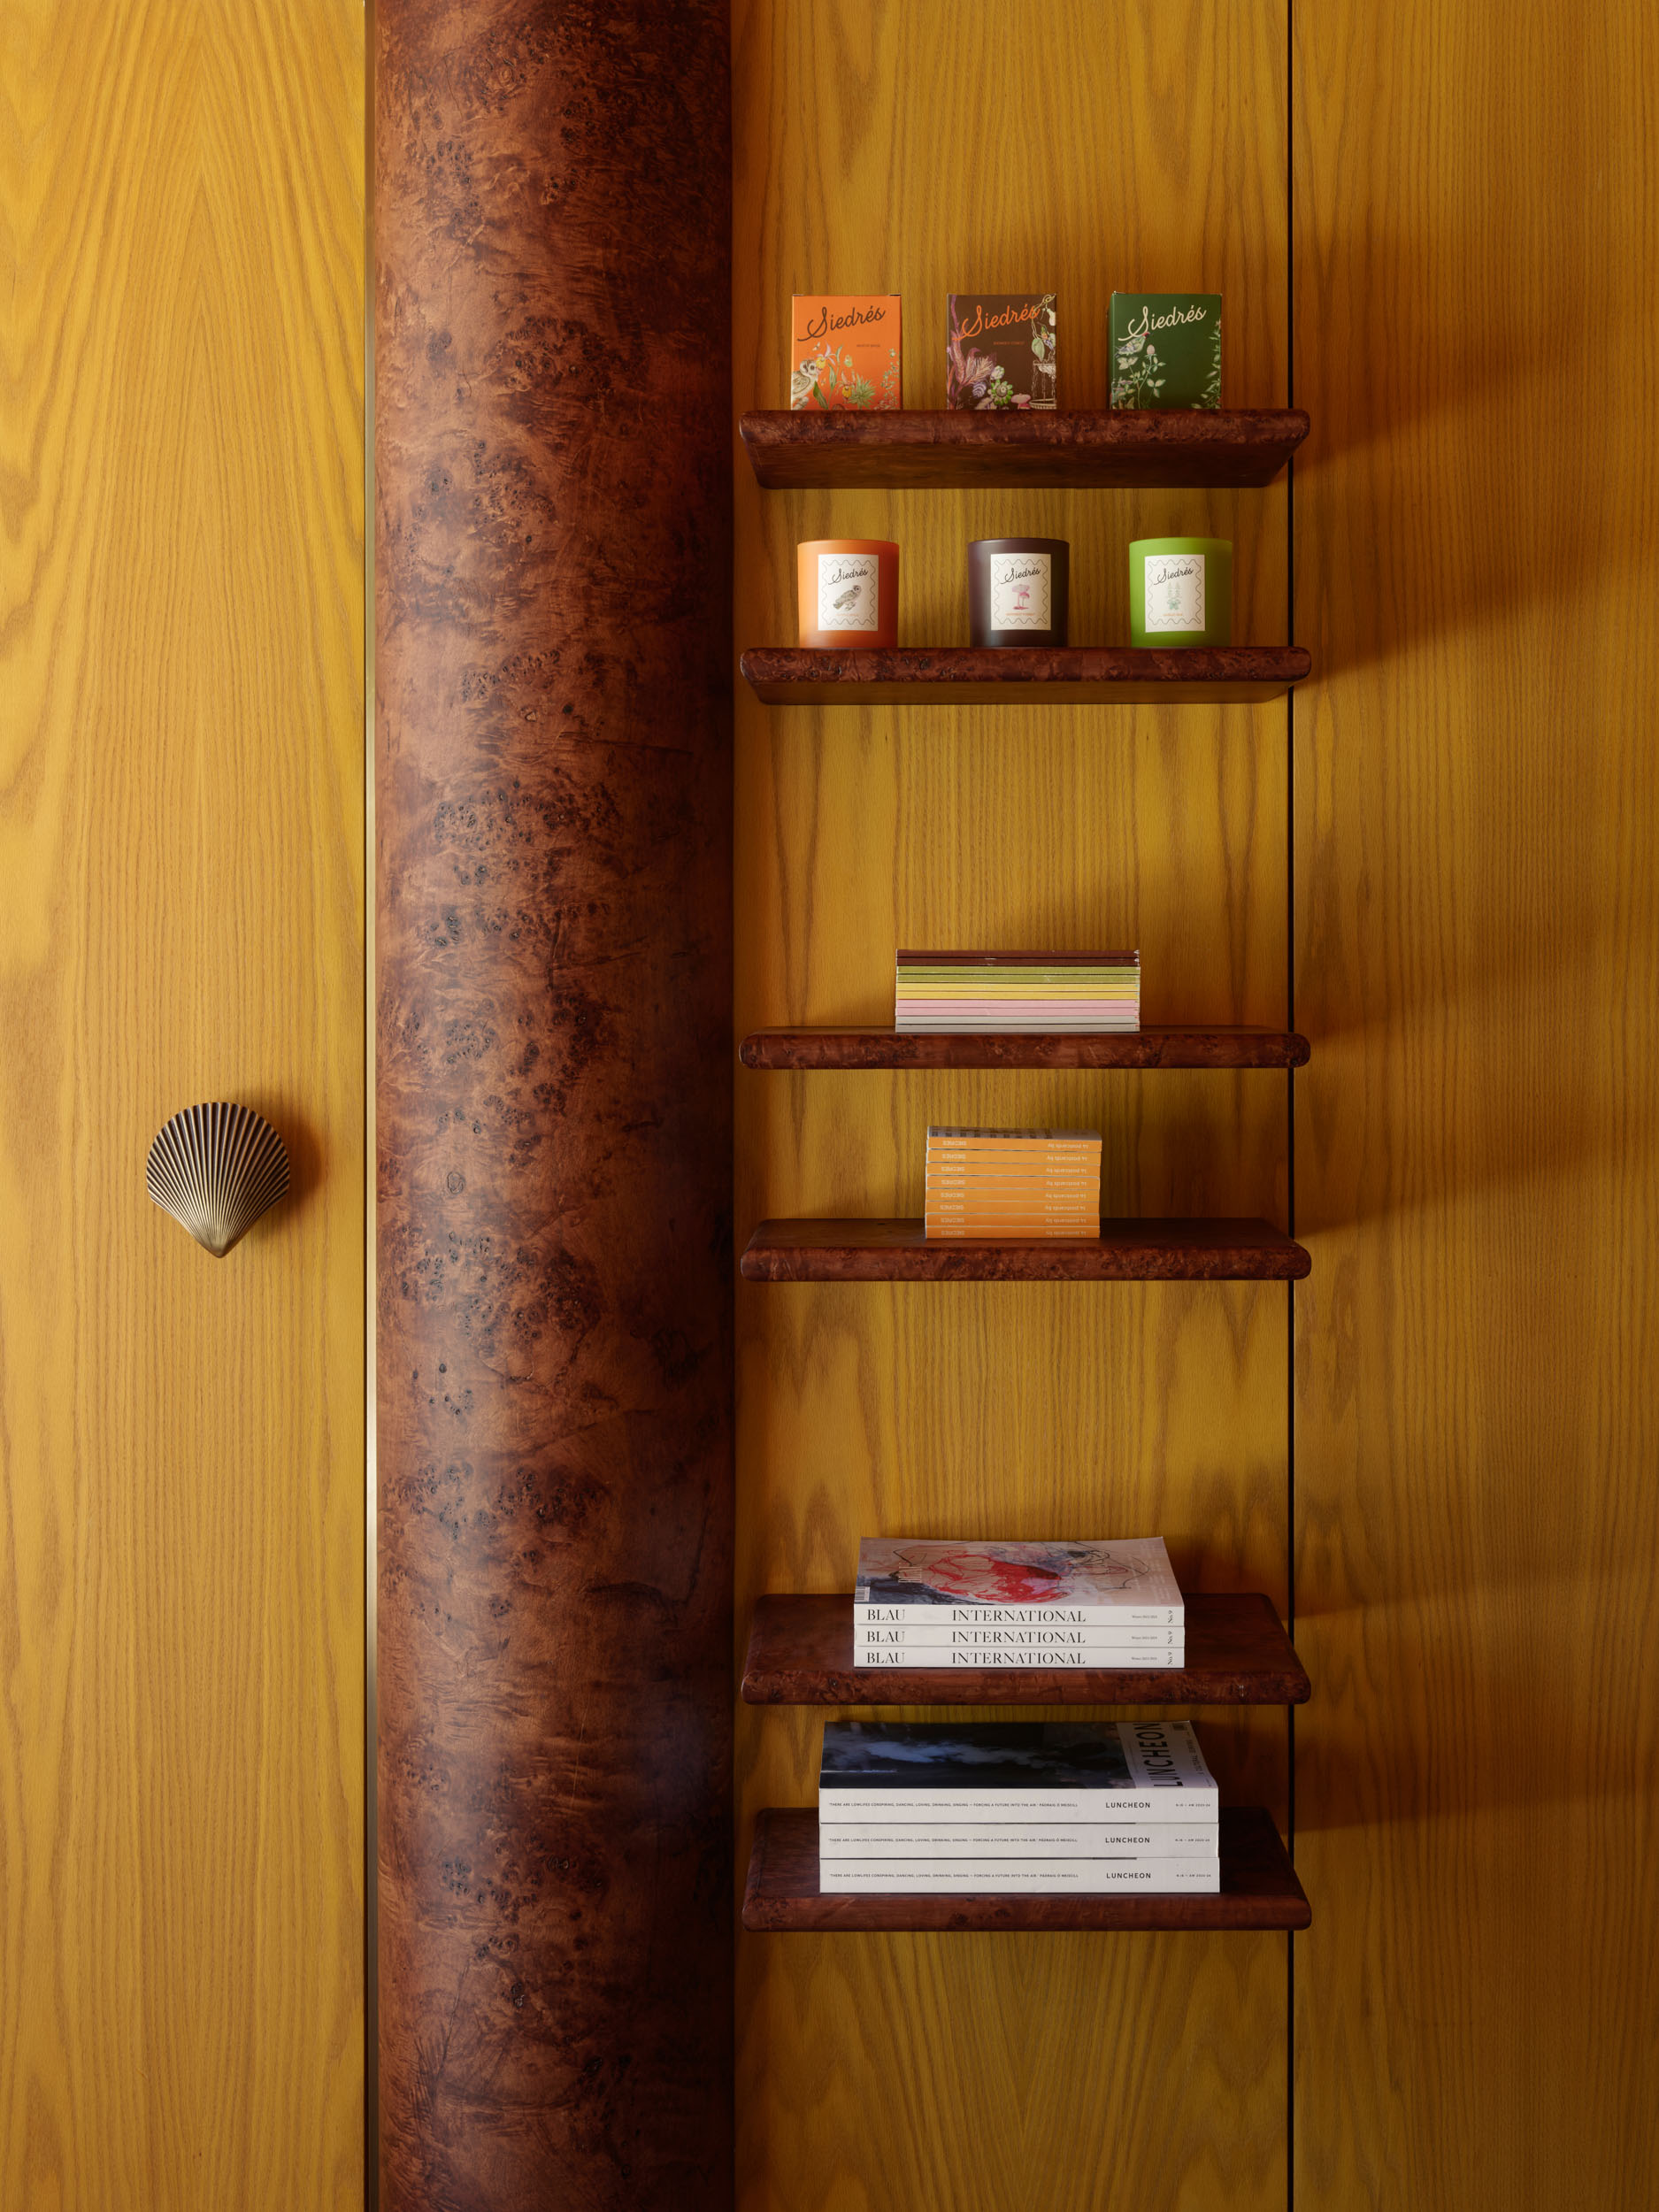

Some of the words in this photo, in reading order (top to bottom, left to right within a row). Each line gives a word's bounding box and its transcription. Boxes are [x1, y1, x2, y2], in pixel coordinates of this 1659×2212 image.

[797, 306, 886, 342] Siedrés
[951, 303, 1041, 342] Siedrés
[1118, 304, 1207, 342] Siedrés
[828, 567, 869, 585] Siedrés
[1000, 567, 1041, 584] Siedrés
[1153, 566, 1194, 585] Siedrés
[868, 1609, 905, 1621] BLAU
[952, 1609, 1086, 1622] INTERNATIONAL
[868, 1631, 905, 1642] BLAU
[952, 1631, 1086, 1644] INTERNATIONAL
[868, 1652, 905, 1663] BLAU
[952, 1652, 1086, 1665] INTERNATIONAL
[1133, 1723, 1183, 1786] LUNCHEON
